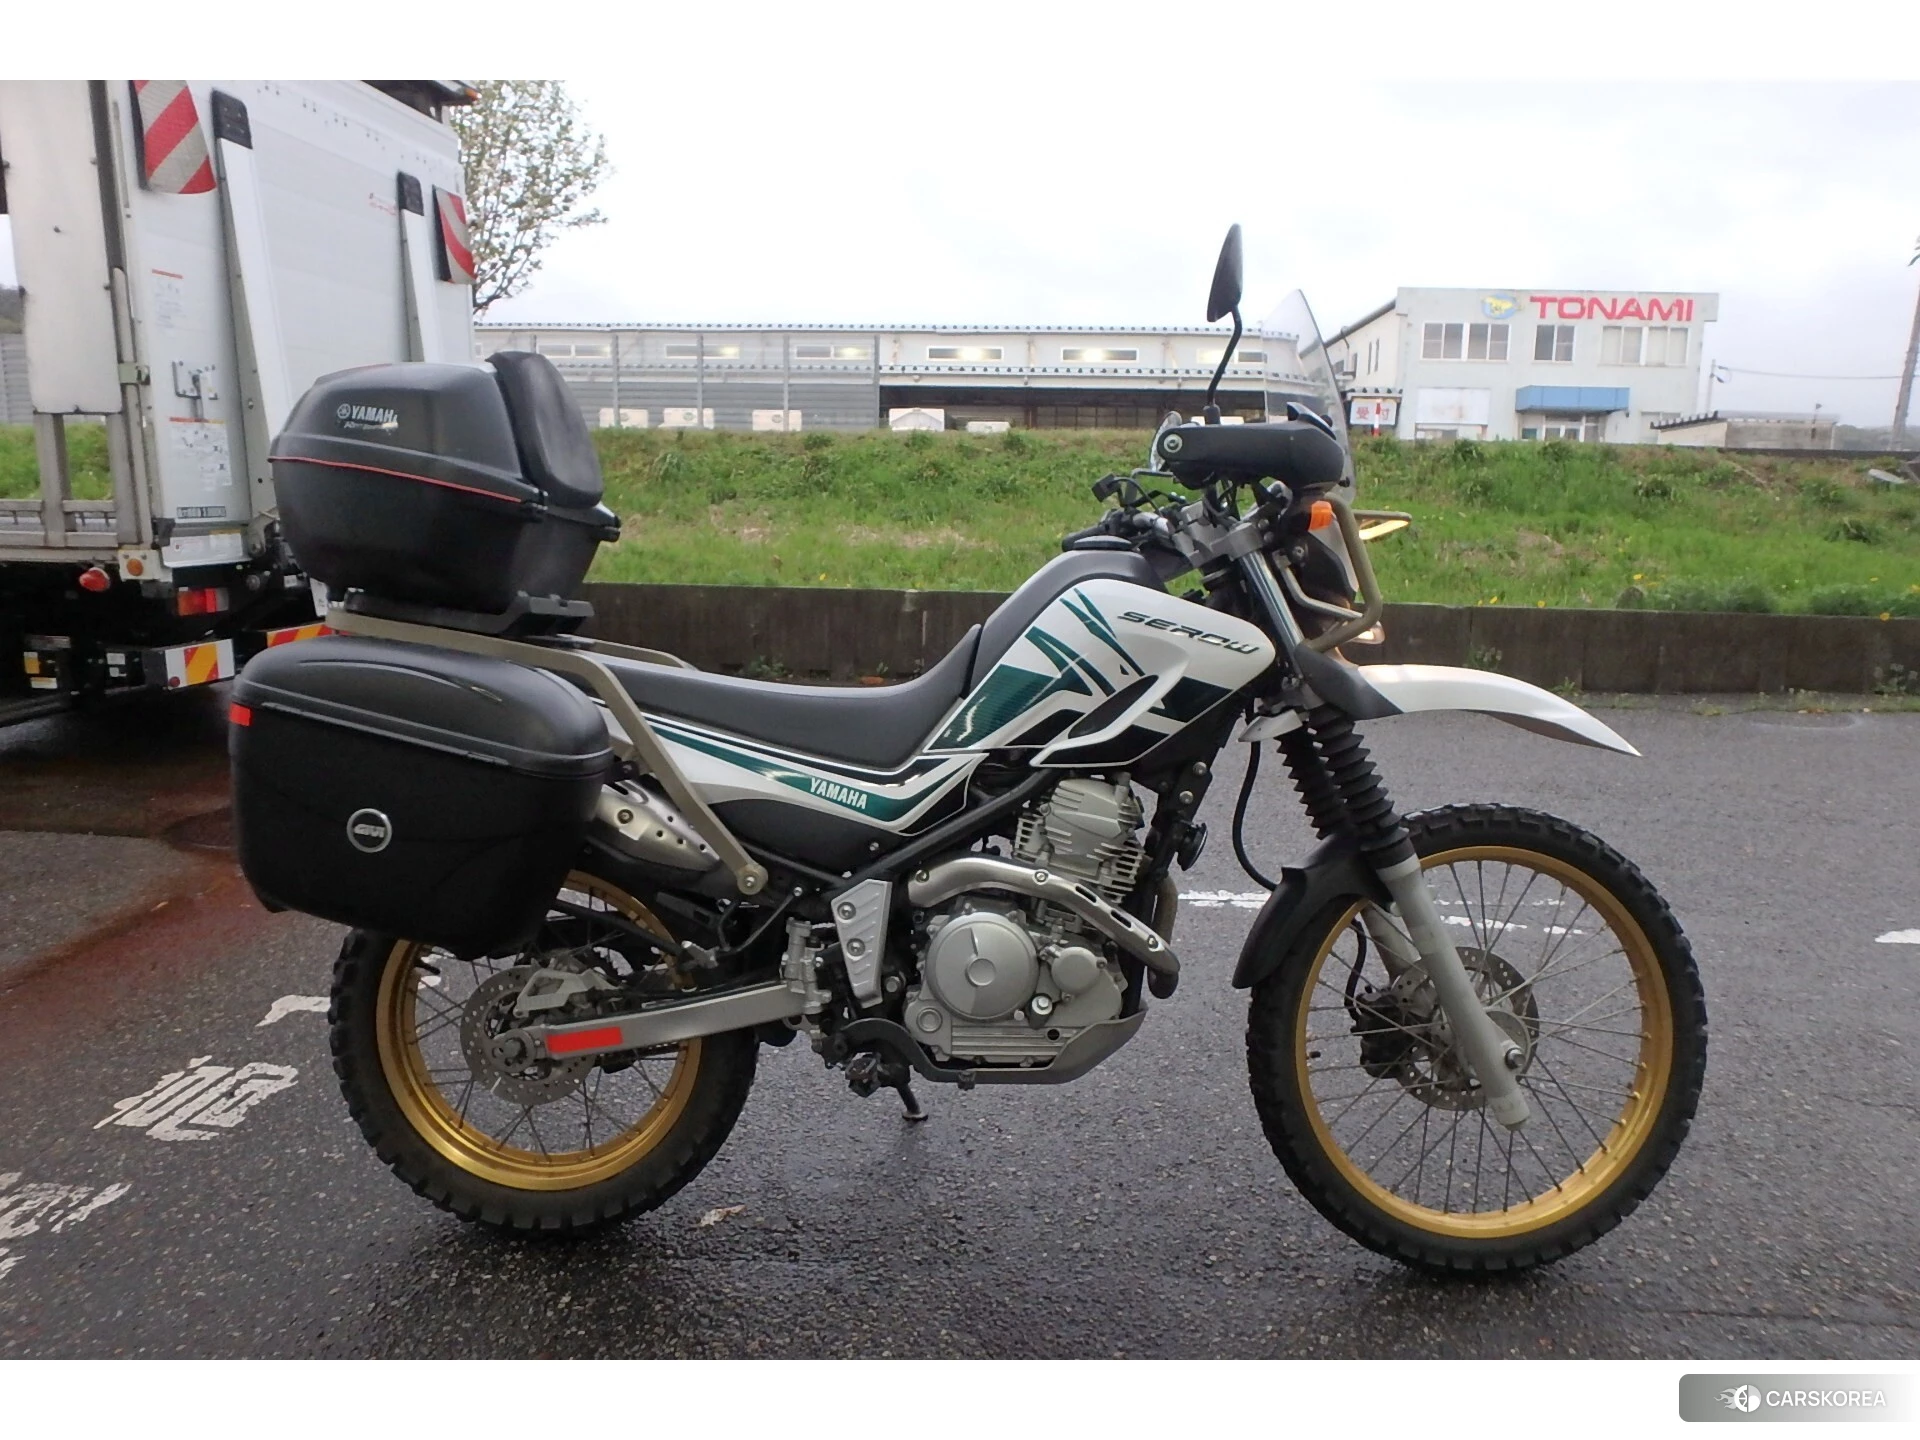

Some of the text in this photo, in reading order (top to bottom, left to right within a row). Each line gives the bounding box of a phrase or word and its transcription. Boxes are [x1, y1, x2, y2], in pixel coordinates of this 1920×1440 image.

[1530, 296, 1694, 321] TONAMI
[1117, 611, 1260, 655] SEROW
[810, 777, 868, 810] YAMAHA
